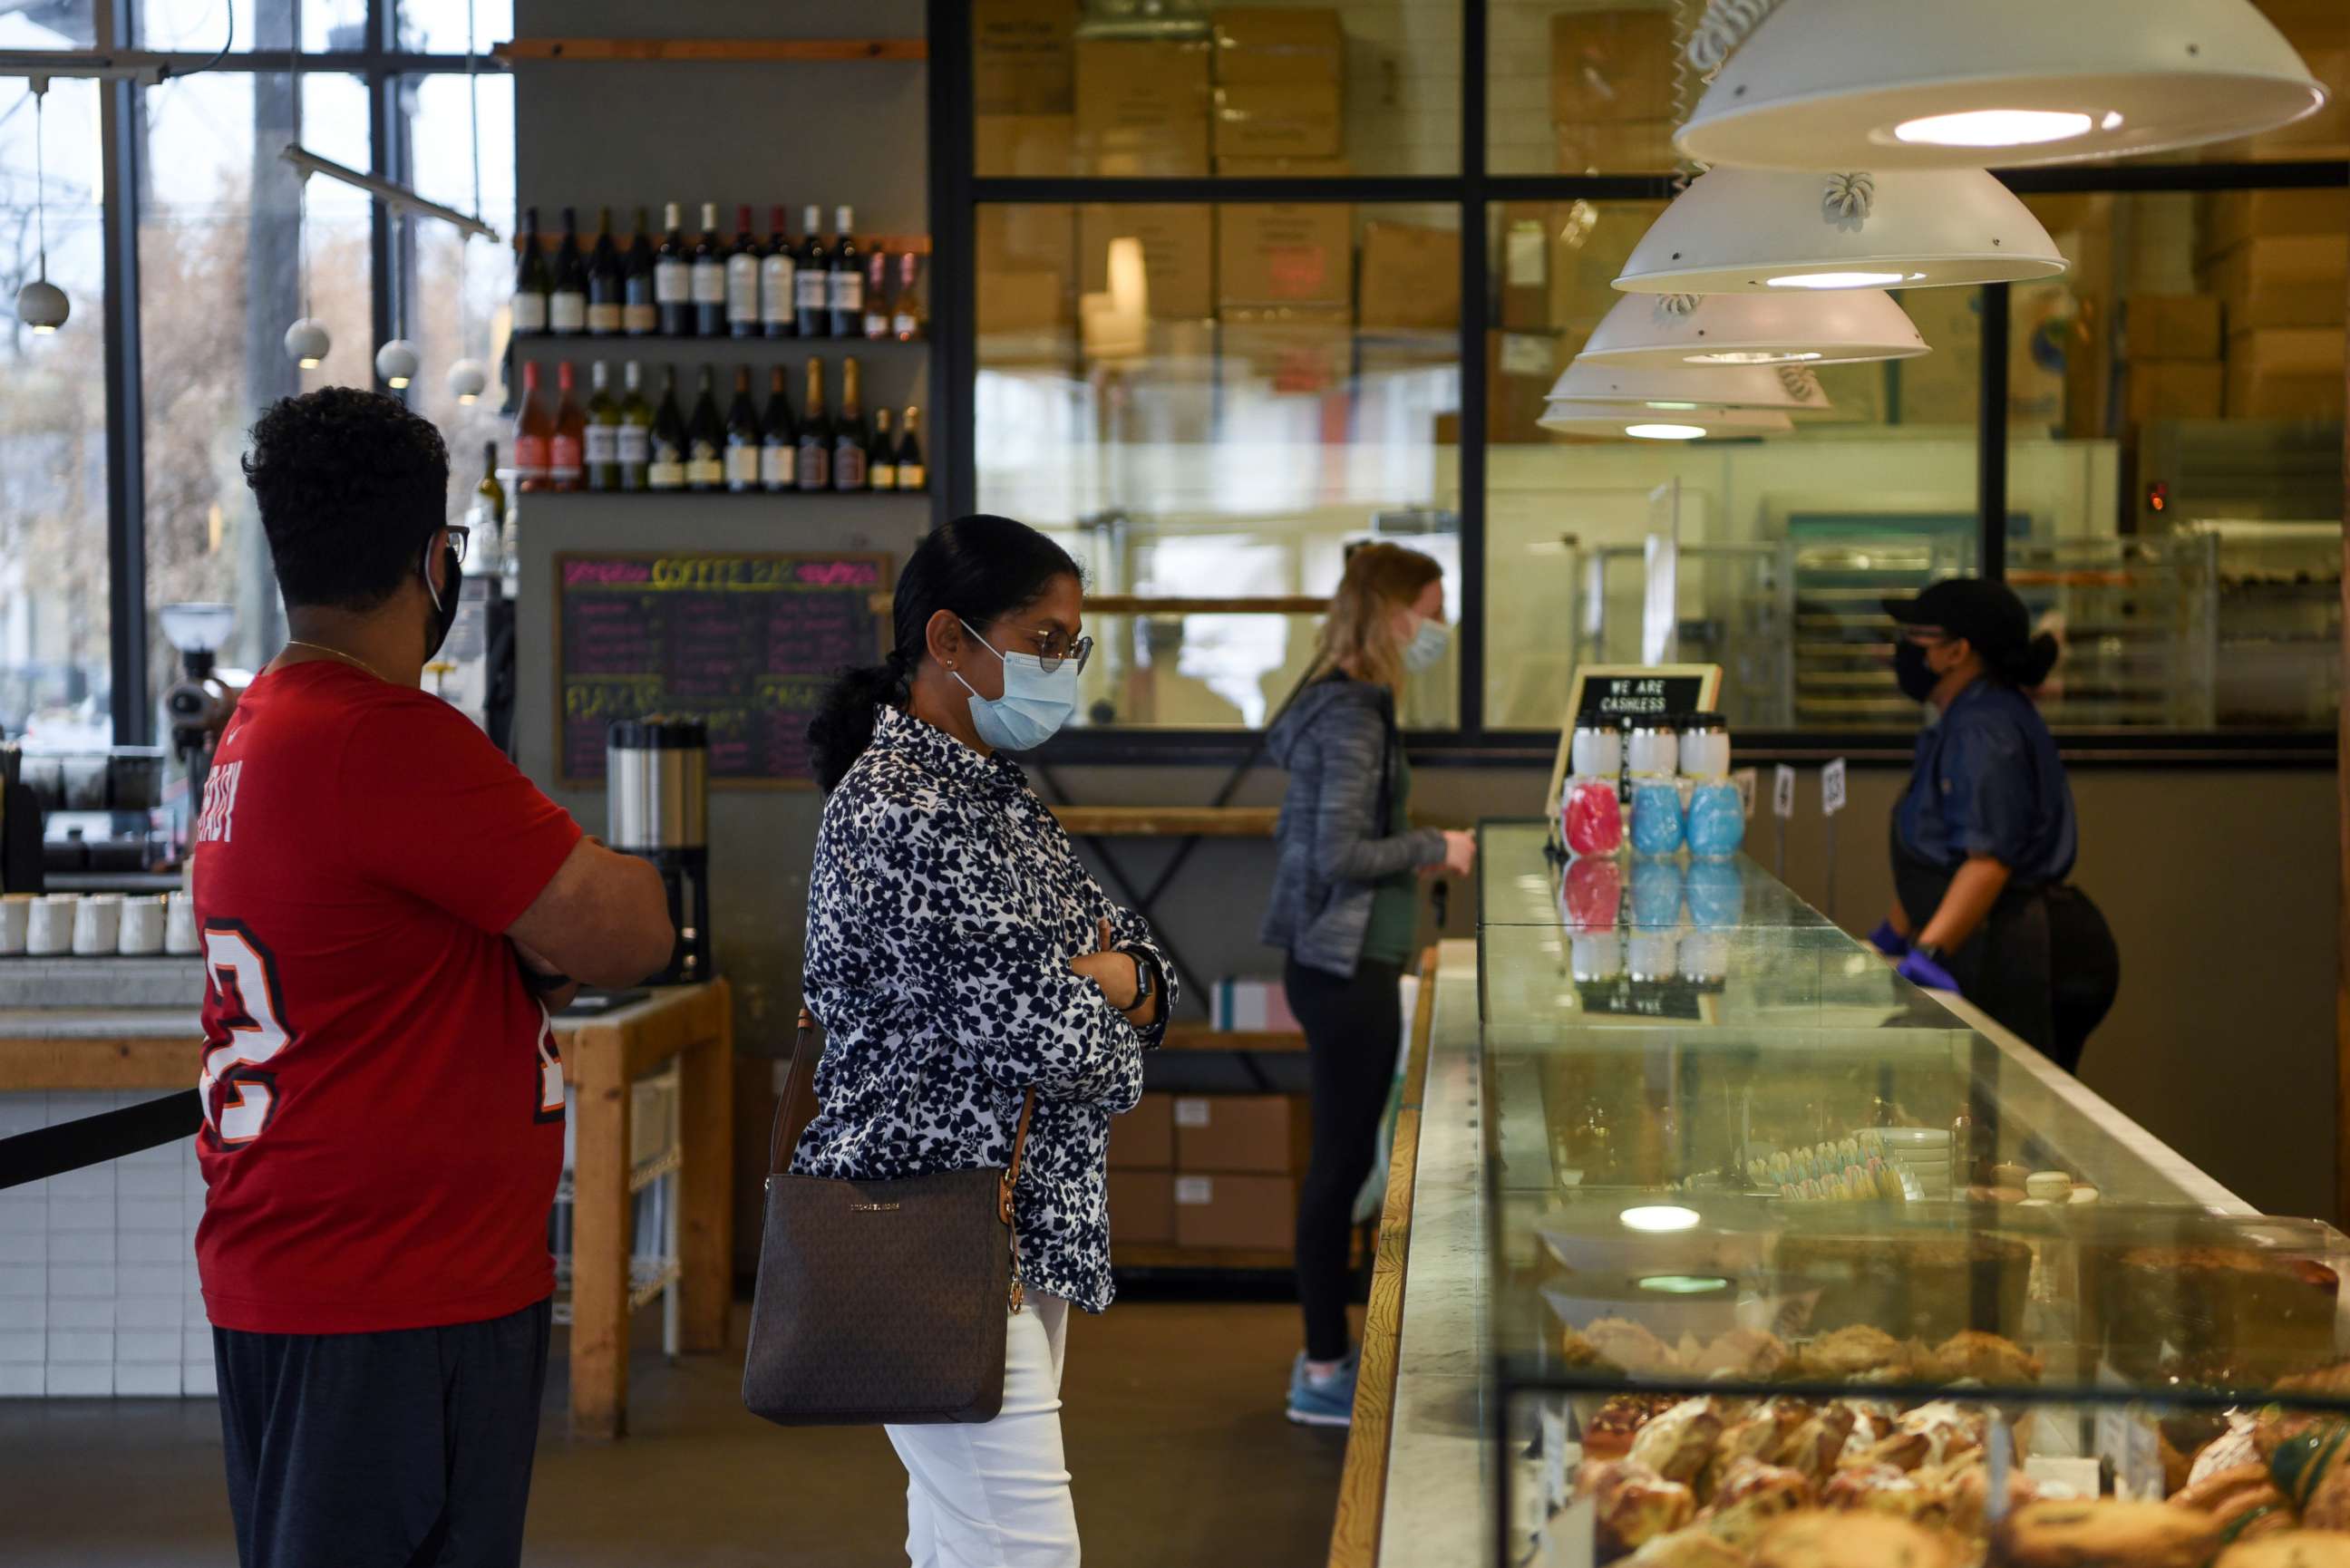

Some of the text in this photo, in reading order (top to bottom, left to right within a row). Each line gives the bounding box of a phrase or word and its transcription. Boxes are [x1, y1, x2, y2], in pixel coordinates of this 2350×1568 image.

[652, 558, 743, 589] COFFEE
[1610, 680, 1665, 695] WE ARE
[1599, 697, 1665, 712] CASHLESS
